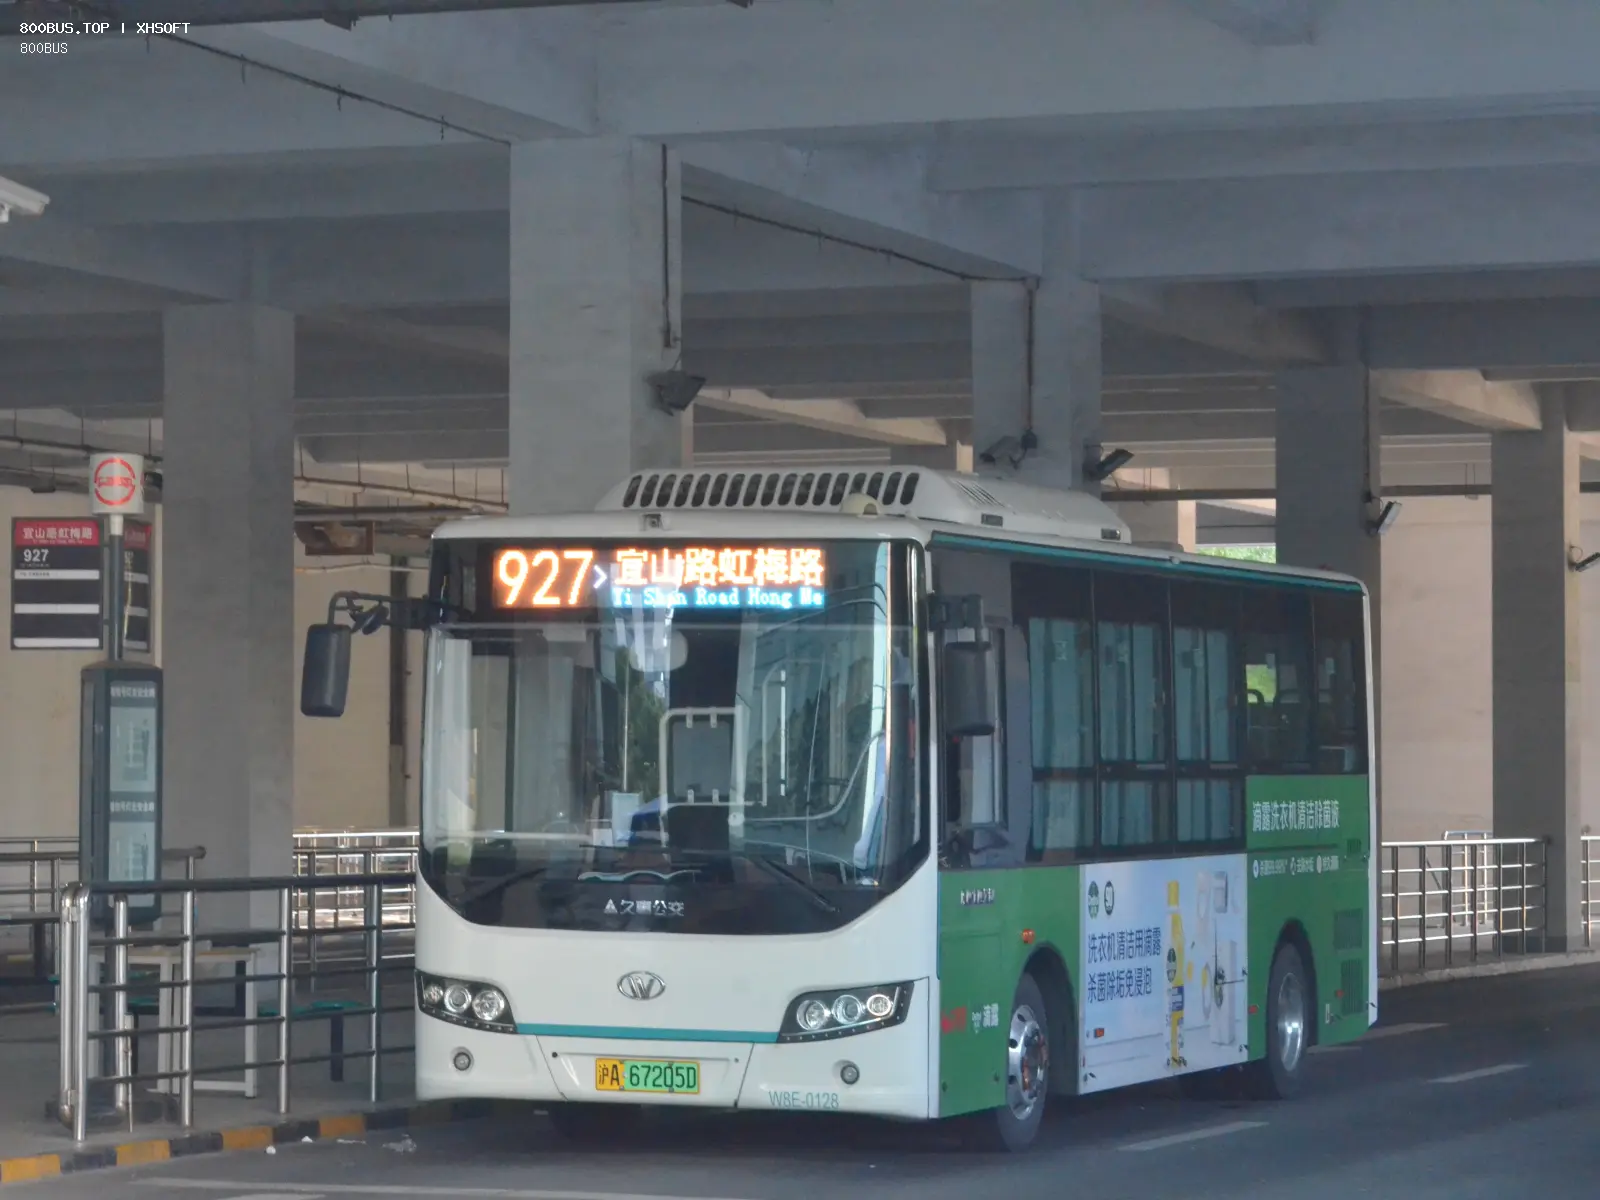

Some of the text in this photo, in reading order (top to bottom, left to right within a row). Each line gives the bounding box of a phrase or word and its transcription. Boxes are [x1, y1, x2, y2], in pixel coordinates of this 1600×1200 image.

[23, 548, 49, 562] 927
[612, 548, 825, 587] 宜山路虹梅路
[498, 548, 594, 606] 927
[694, 586, 740, 606] Road
[747, 586, 793, 609] Hong
[1252, 800, 1339, 832] 滴露洗衣机清洁除菌液
[620, 899, 685, 917] 久公交
[1088, 926, 1161, 964] 洗衣机清洁用滴露
[1088, 965, 1152, 1003] 杀菌除垢免浸泡
[768, 1091, 839, 1110] W8E-0128
